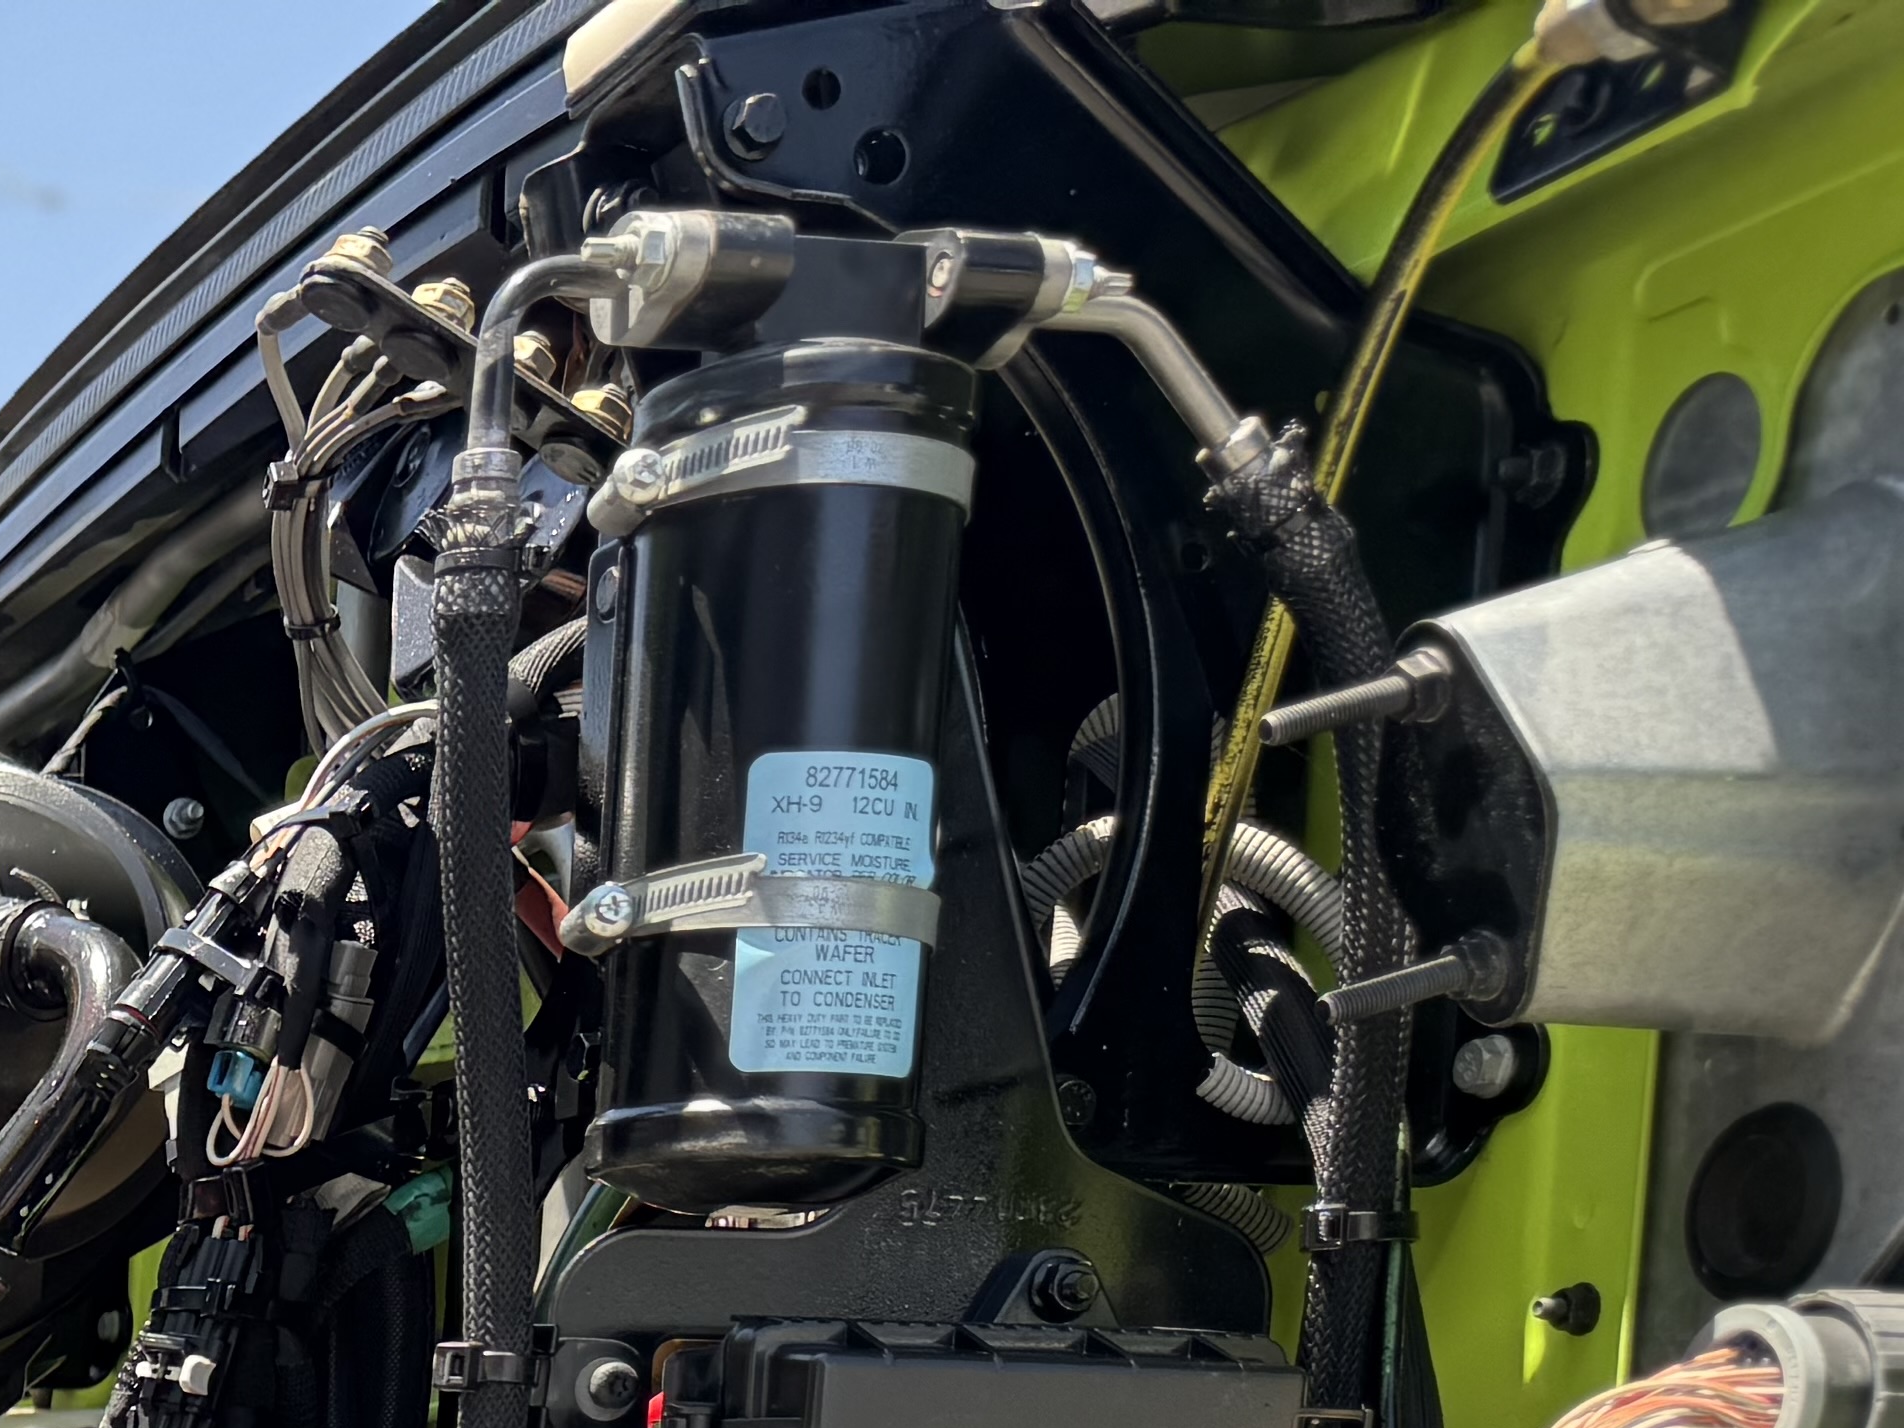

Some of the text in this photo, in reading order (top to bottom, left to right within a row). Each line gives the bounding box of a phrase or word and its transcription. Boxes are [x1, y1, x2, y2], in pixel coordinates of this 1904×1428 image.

[806, 766, 899, 791] 82771584
[771, 795, 895, 816] XH-9 12CU
[778, 853, 911, 872] SERVICE MOISTURE
[775, 928, 847, 942] CONTAINS
[815, 944, 874, 963] WAFER
[780, 969, 896, 989] CONNECT INLET
[780, 990, 895, 1011] TO CONDENSER
